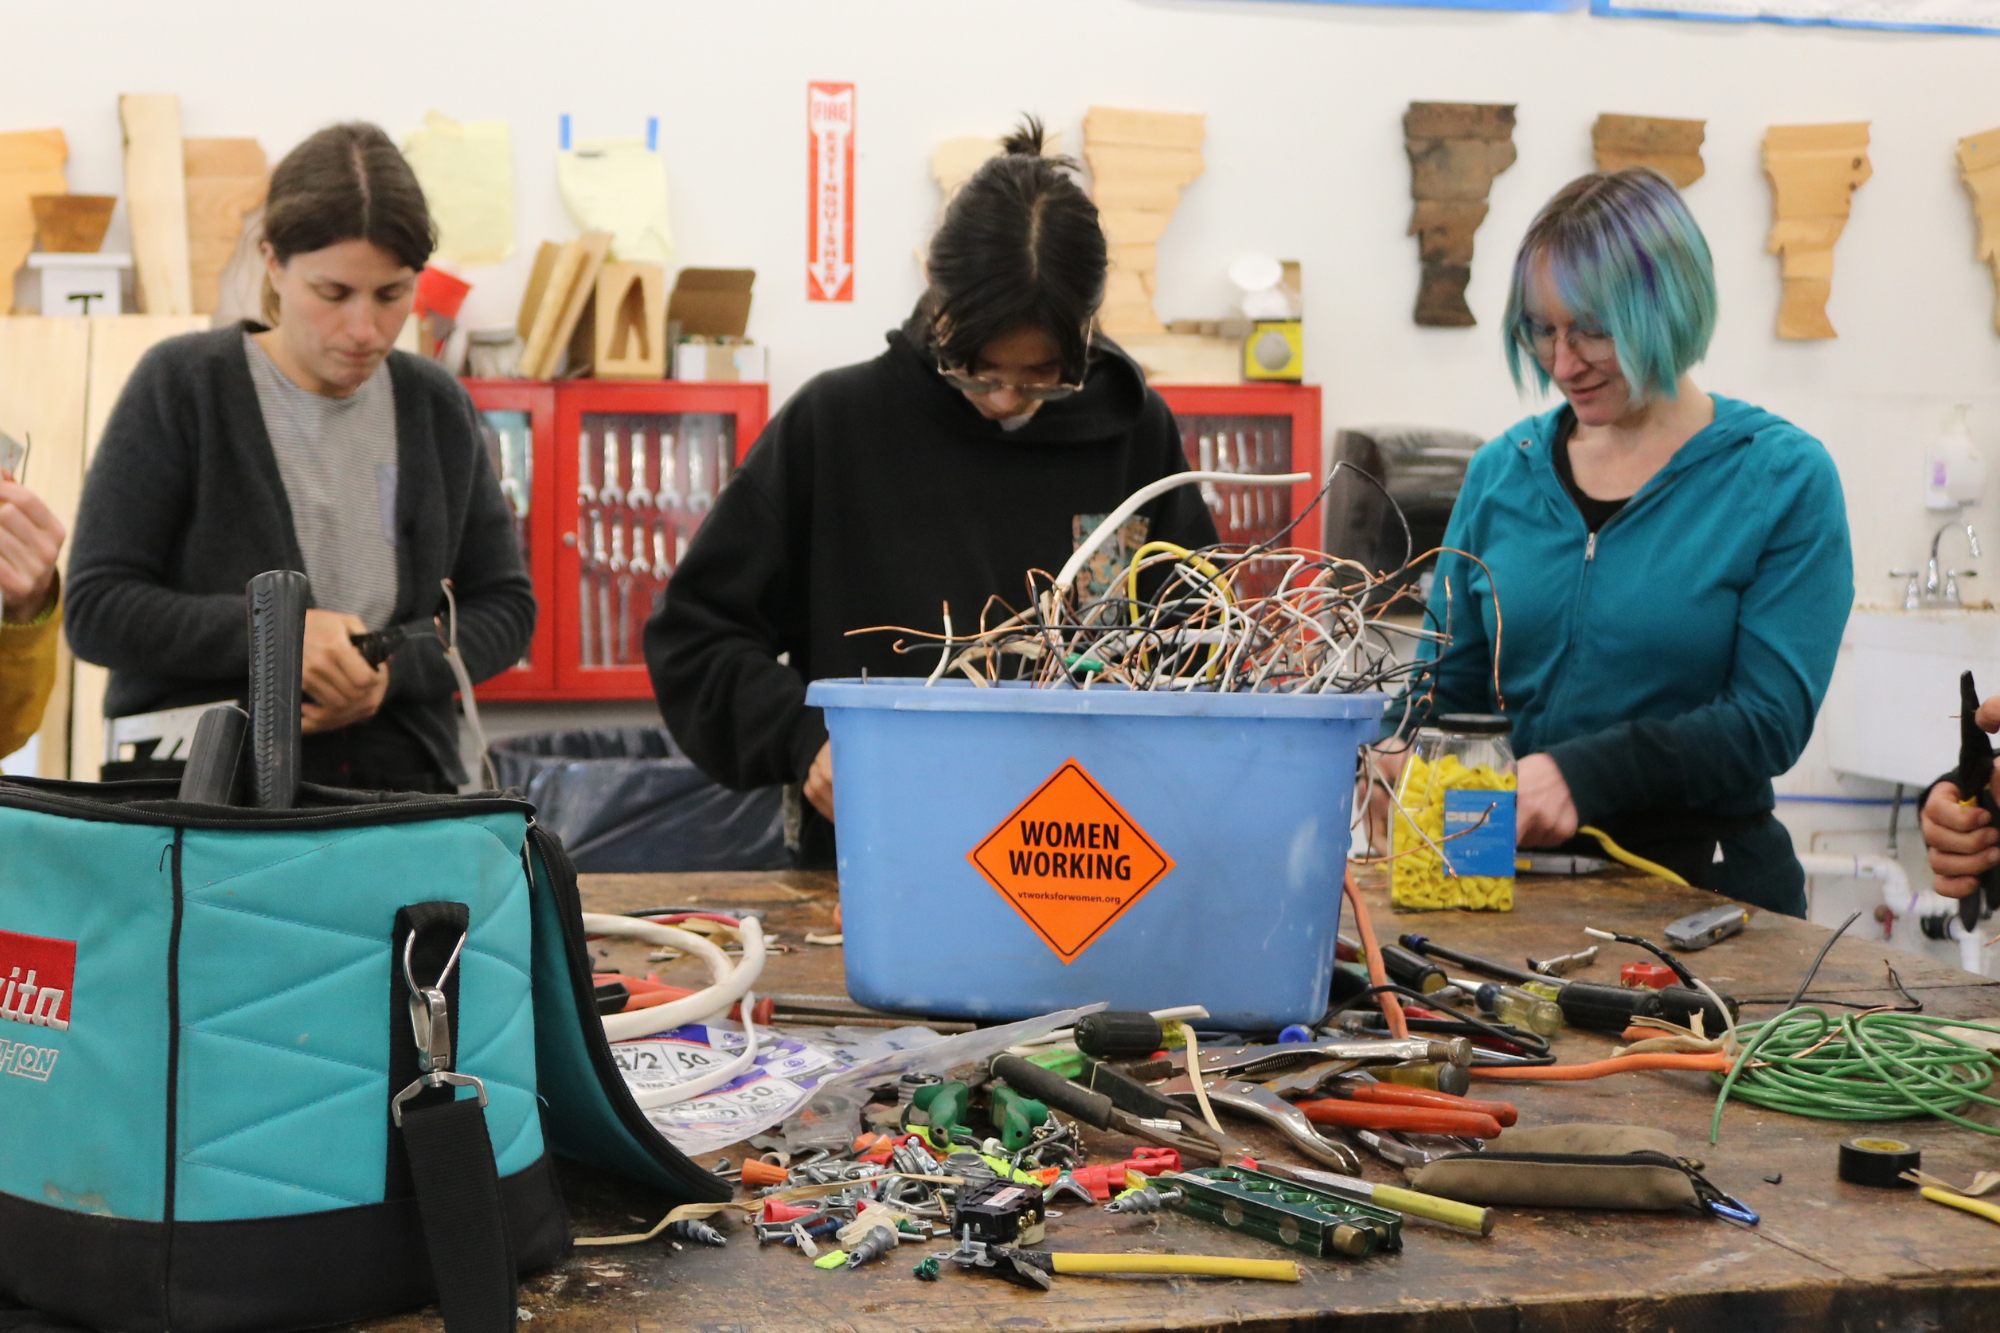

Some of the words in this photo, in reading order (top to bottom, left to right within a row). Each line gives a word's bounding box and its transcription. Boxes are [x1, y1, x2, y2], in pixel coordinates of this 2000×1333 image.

[812, 101, 848, 122] FIRE
[824, 130, 837, 285] EXTINGUISHER
[1020, 820, 1120, 850] WOMEN
[1008, 850, 1132, 881] WORKING
[1017, 891, 1121, 905] vtworksforwomen.org
[0, 966, 70, 1032] ita
[676, 1050, 711, 1069] 50
[736, 1086, 774, 1103] 50
